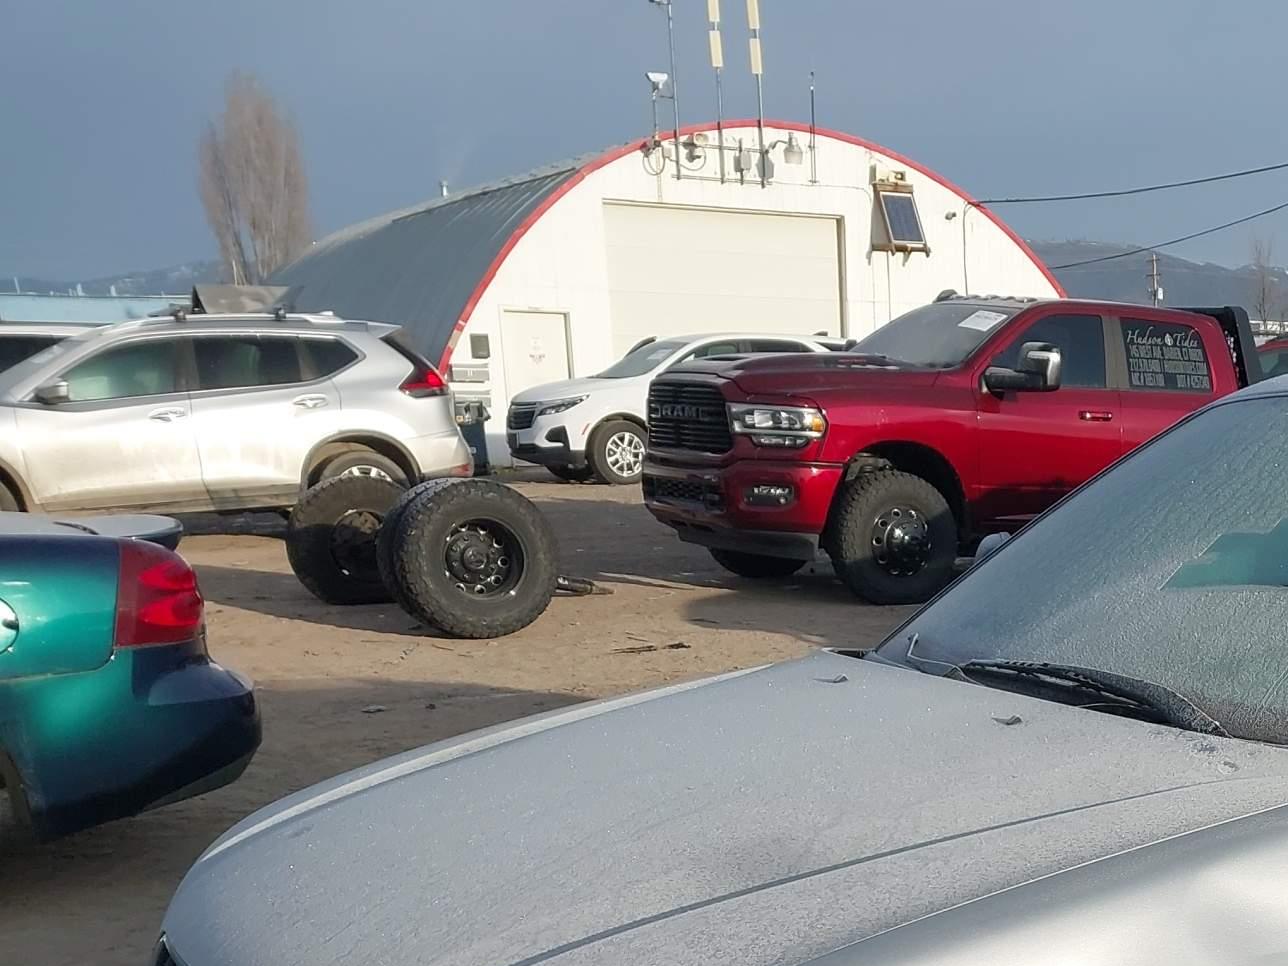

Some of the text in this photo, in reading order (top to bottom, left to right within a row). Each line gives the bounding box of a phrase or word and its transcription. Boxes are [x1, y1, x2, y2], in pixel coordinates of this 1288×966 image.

[1127, 326, 1198, 348] Hudson Tides
[662, 404, 696, 417] RAM
